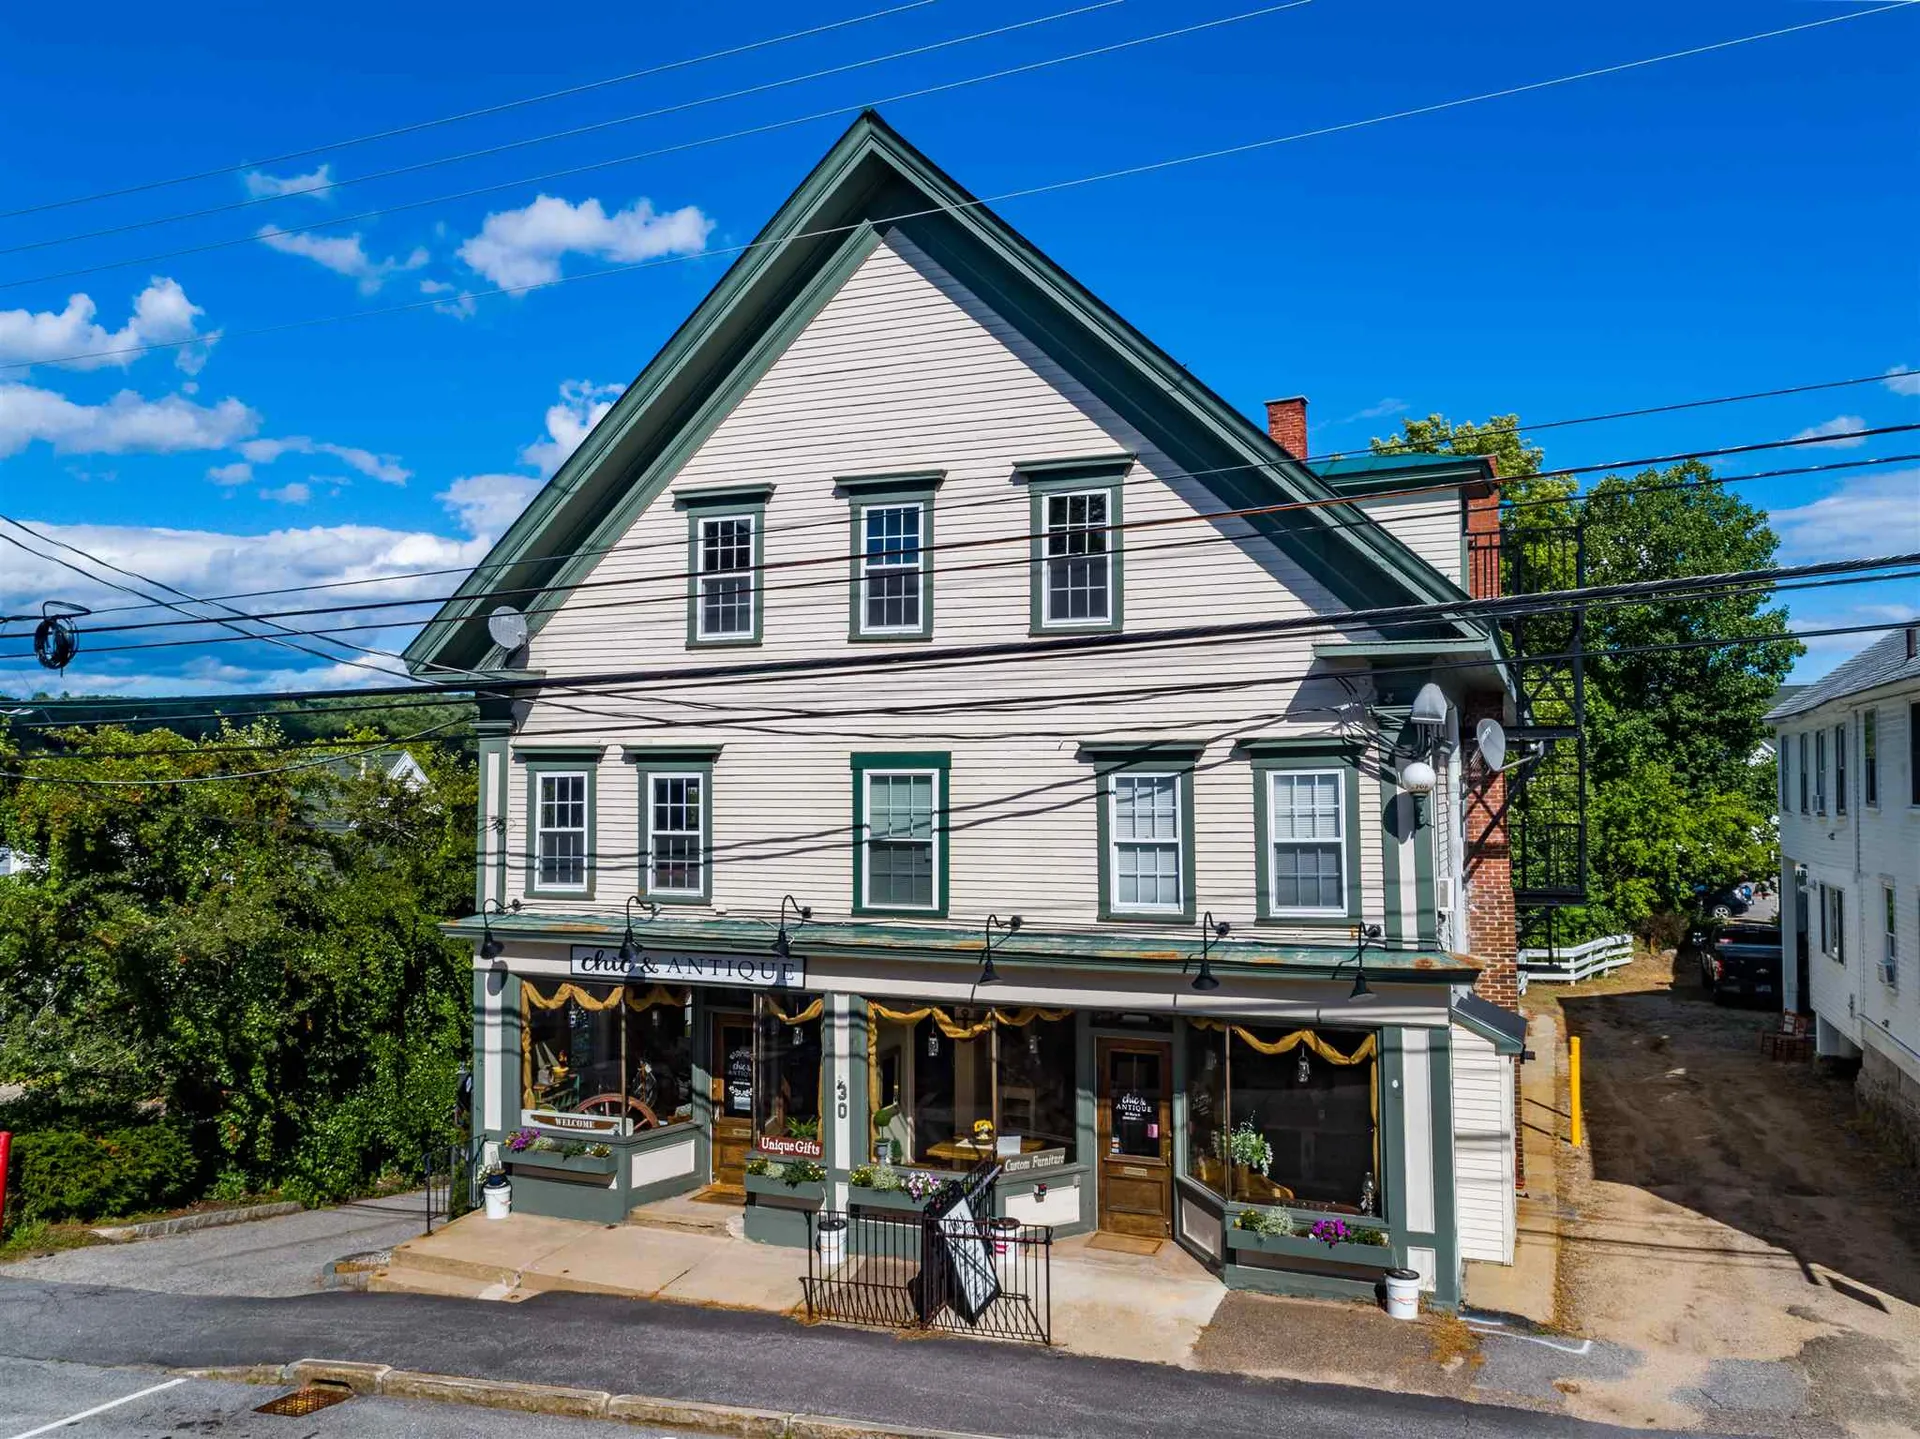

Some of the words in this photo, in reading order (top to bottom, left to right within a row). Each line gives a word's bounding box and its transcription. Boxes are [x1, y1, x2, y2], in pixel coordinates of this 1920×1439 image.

[581, 949, 635, 973] chic
[640, 956, 660, 974] &
[666, 956, 795, 982] ANTIQUE
[1122, 1093, 1140, 1105] chic
[1115, 1103, 1152, 1113] ANTIQUE
[554, 1117, 595, 1129] WELCOME
[761, 1137, 795, 1154] Unique
[795, 1140, 820, 1155] Gifts
[1005, 1159, 1031, 1171] Custom
[1031, 1154, 1065, 1169] Furniture
